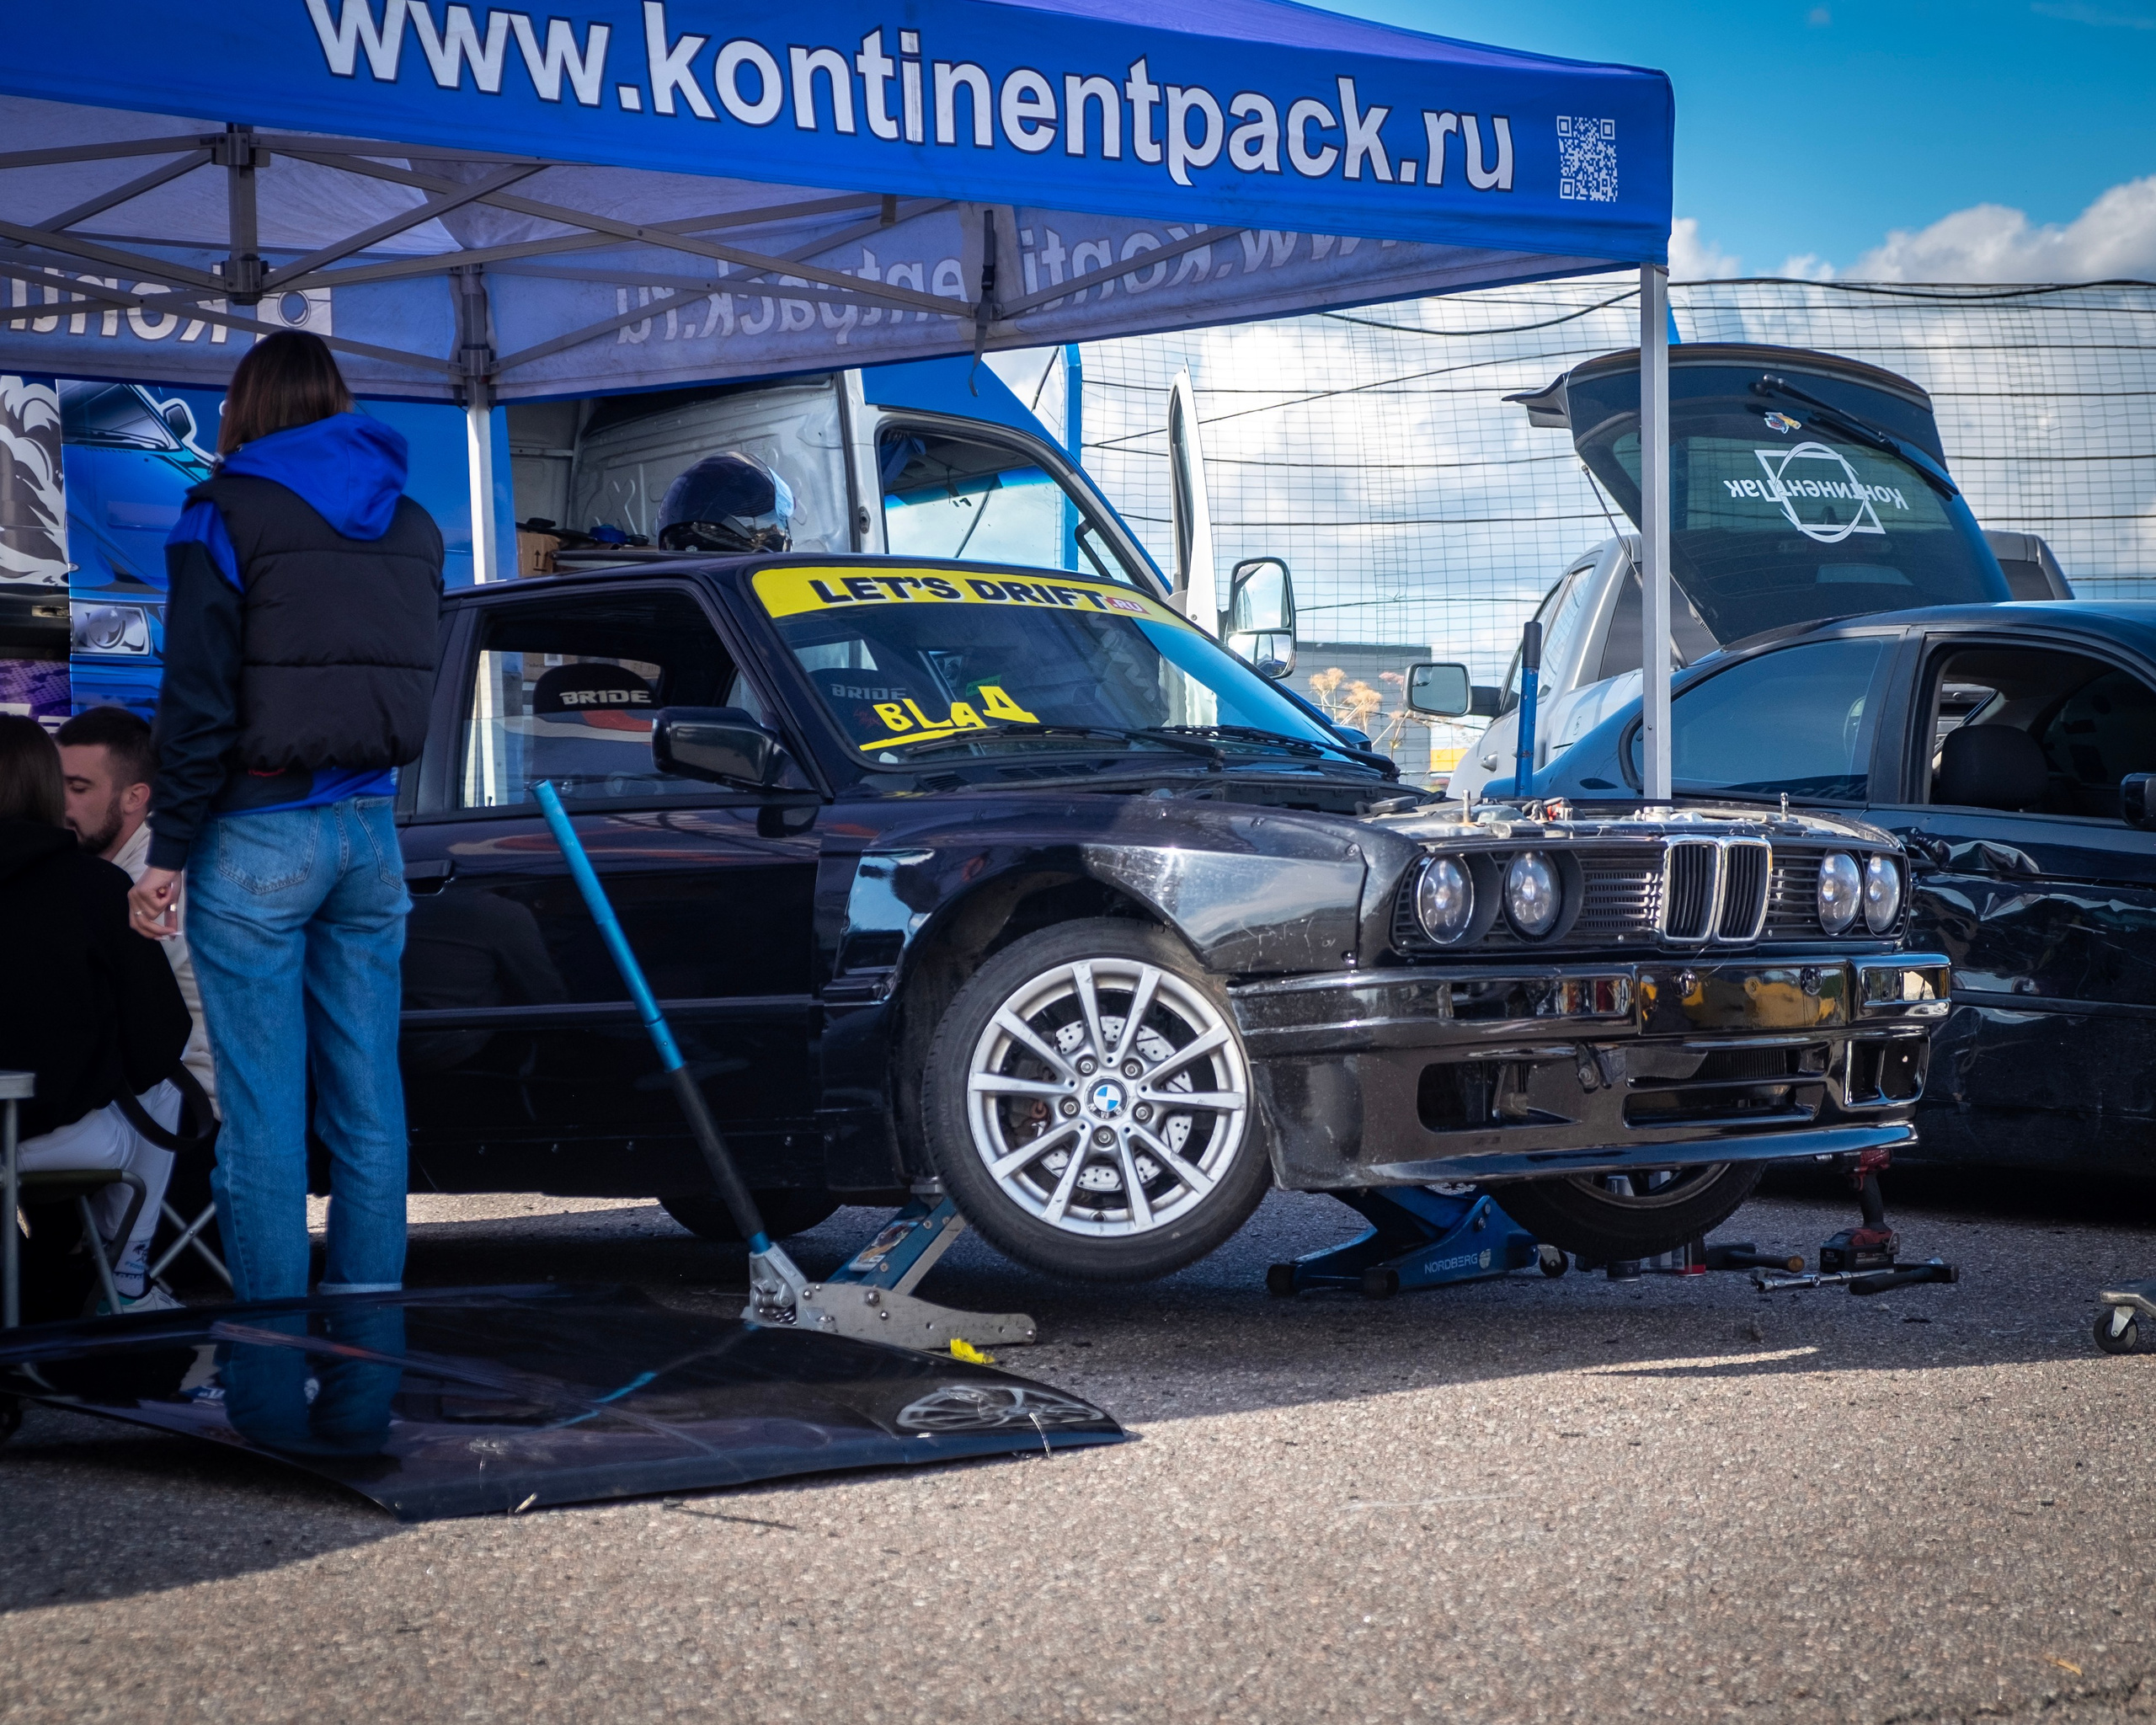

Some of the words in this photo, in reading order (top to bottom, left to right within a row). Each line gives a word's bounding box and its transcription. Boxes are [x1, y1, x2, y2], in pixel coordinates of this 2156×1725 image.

[305, 0, 1513, 187] www.kontinentpack.ru
[808, 576, 963, 604] LET'S
[559, 690, 652, 706] BRIDE
[830, 683, 907, 701] BRIDE
[1424, 1253, 1478, 1274] NORDBERG
